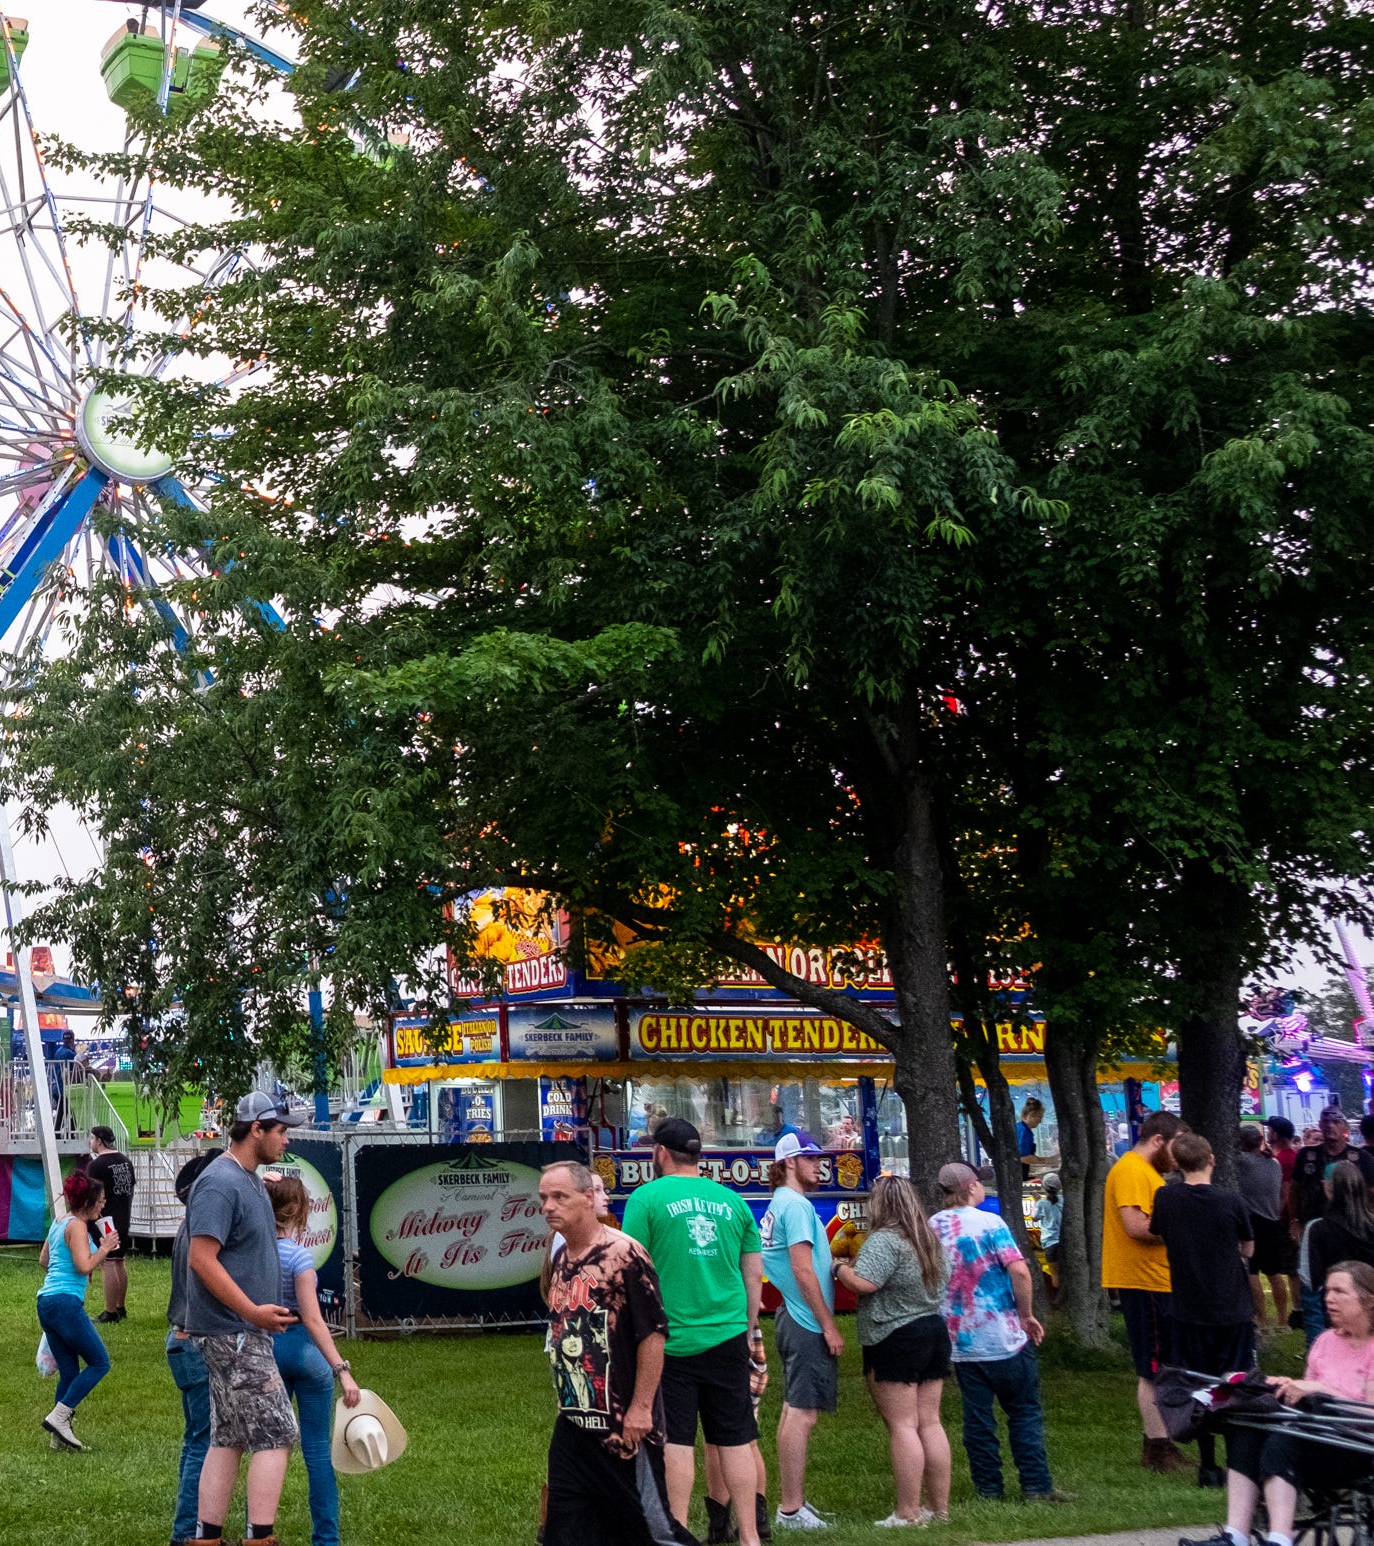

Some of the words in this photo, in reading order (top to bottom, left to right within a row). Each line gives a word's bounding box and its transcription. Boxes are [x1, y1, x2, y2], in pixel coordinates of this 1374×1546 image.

[506, 955, 565, 990] TENDERS
[524, 1032, 563, 1043] SKERBECK
[565, 1032, 595, 1043] FAMILY
[641, 1016, 765, 1050] CHICKEN
[470, 1038, 492, 1053] POLISH
[551, 1080, 567, 1091] ICE
[547, 1092, 572, 1103] COLD
[465, 1108, 491, 1120] FRIES
[437, 1173, 480, 1186] SKERBECK
[482, 1172, 510, 1185] FAMILY
[452, 1188, 497, 1202] Carnival
[666, 1199, 693, 1217] IRISH
[386, 1208, 486, 1242] Midway
[387, 1248, 426, 1281] At
[439, 1240, 483, 1270] Its
[585, 1416, 610, 1430] HELL
